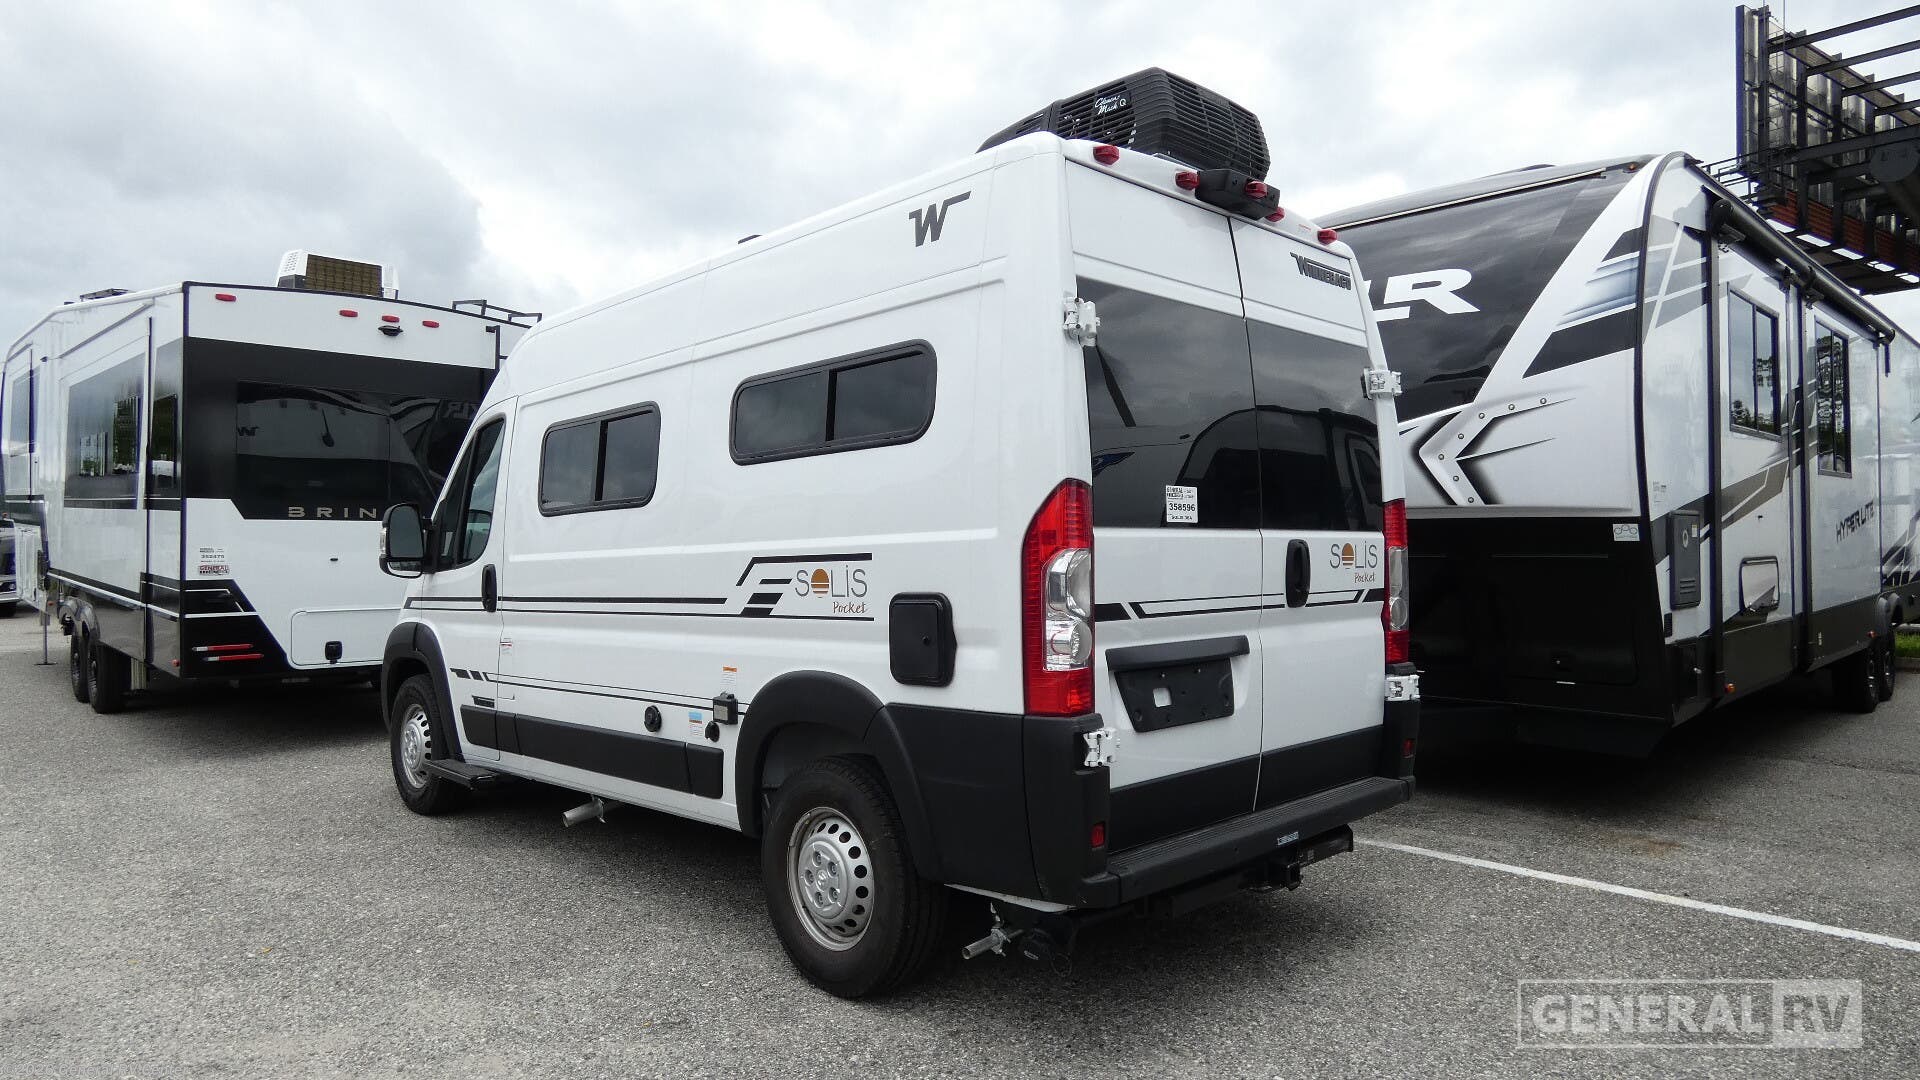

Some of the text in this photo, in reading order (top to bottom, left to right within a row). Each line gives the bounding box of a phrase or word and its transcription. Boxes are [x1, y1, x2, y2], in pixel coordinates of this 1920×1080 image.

[1119, 98, 1127, 107] Q
[908, 190, 972, 248] W
[1169, 502, 1196, 512] 358596
[1354, 571, 1376, 583] Pocket
[832, 601, 867, 614] Pocket
